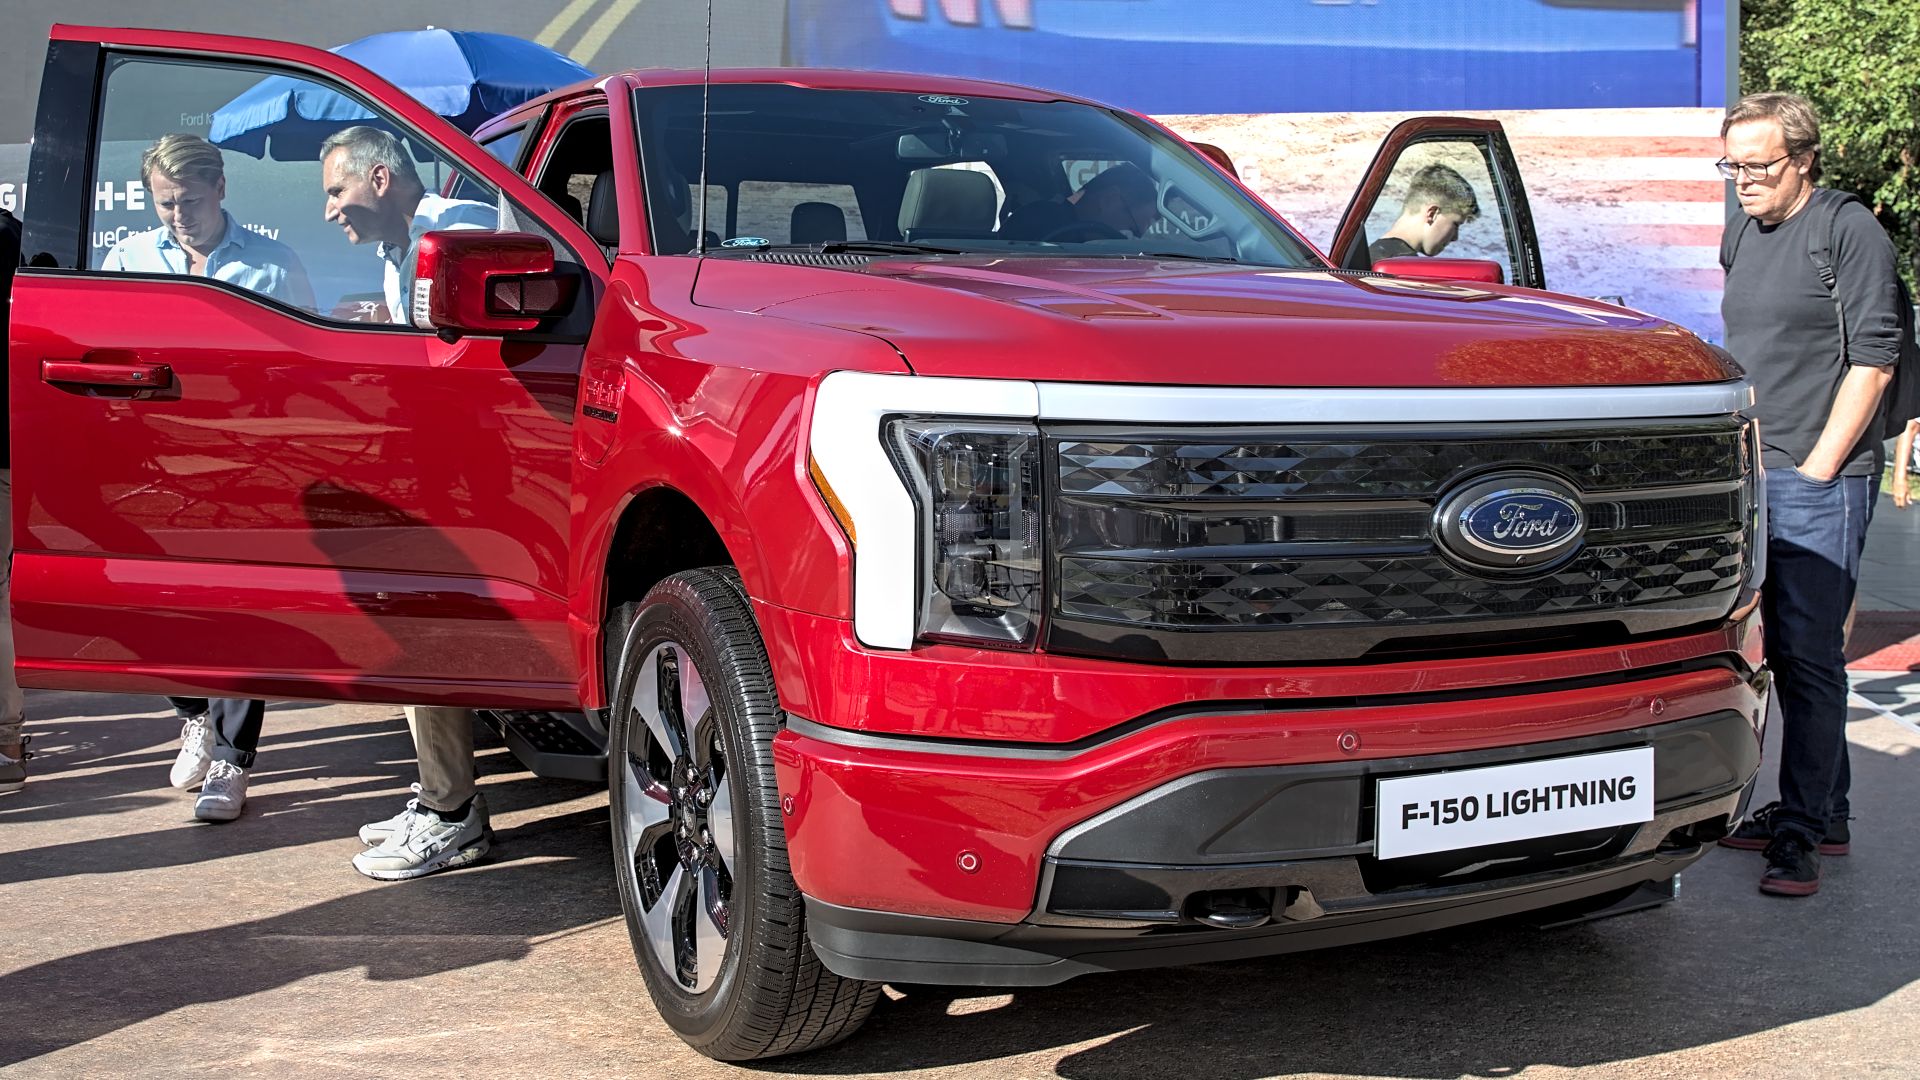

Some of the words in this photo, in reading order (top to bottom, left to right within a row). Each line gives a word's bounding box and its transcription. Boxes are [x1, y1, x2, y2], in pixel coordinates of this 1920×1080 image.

[180, 113, 204, 126] Ford
[0, 183, 17, 212] G
[95, 181, 145, 211] H-E
[1493, 502, 1560, 539] Ford
[1402, 796, 1479, 830] F-150
[1486, 776, 1636, 819] LIGHTNING
